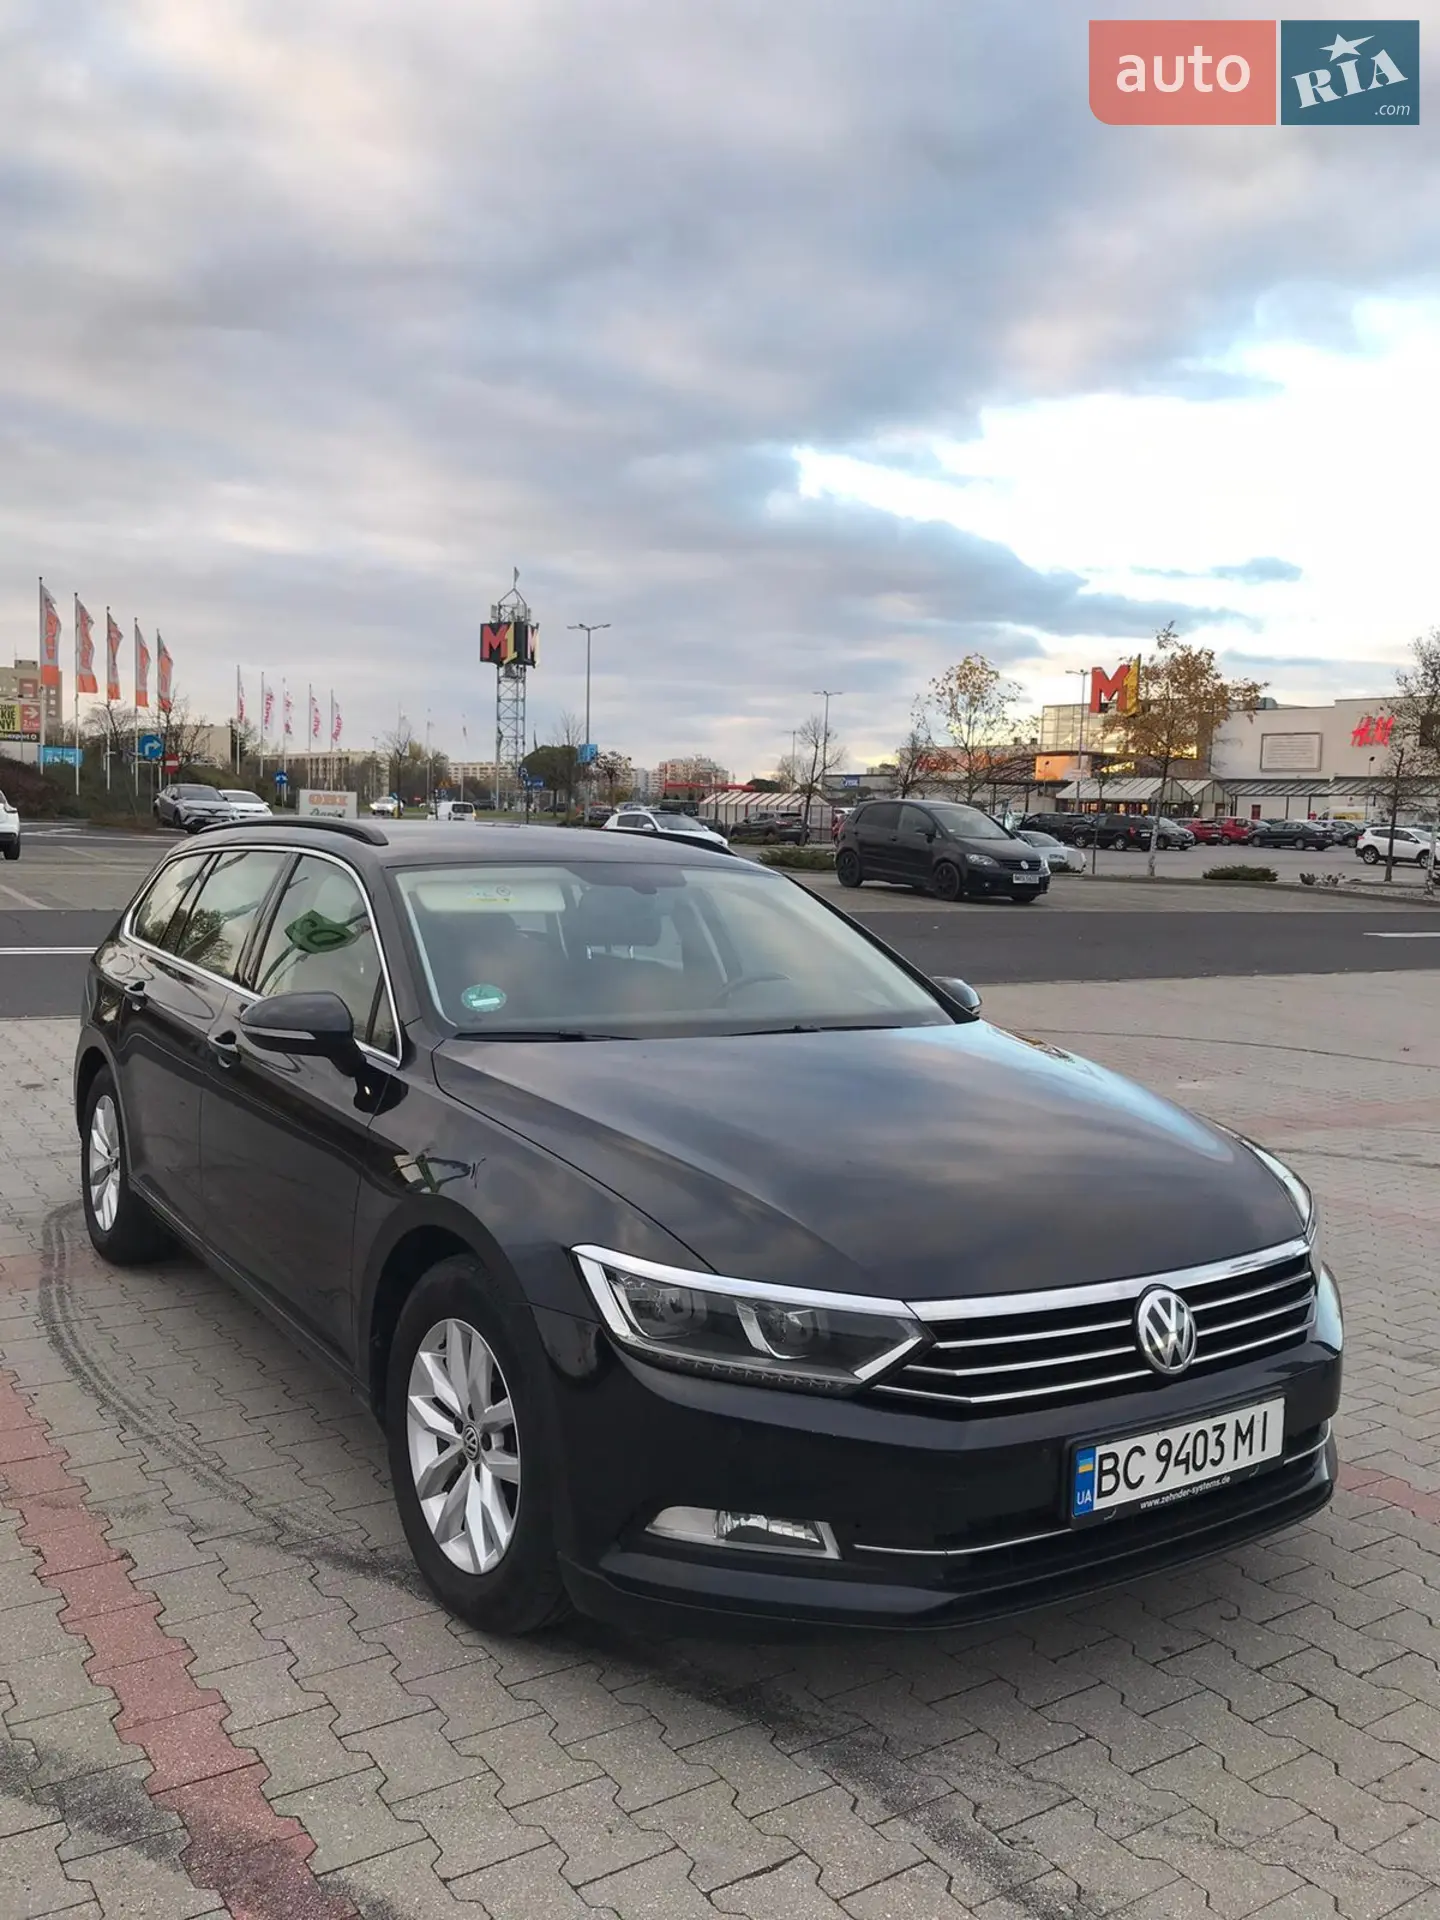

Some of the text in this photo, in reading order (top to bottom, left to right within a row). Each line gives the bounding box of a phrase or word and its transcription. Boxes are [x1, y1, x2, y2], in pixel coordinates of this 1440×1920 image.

[1089, 654, 1141, 717] M1
[1097, 1410, 1268, 1499] BC 9403 MI
[1076, 1489, 1092, 1505] UA
[1139, 1475, 1231, 1509] www.zehnder-systems.de
